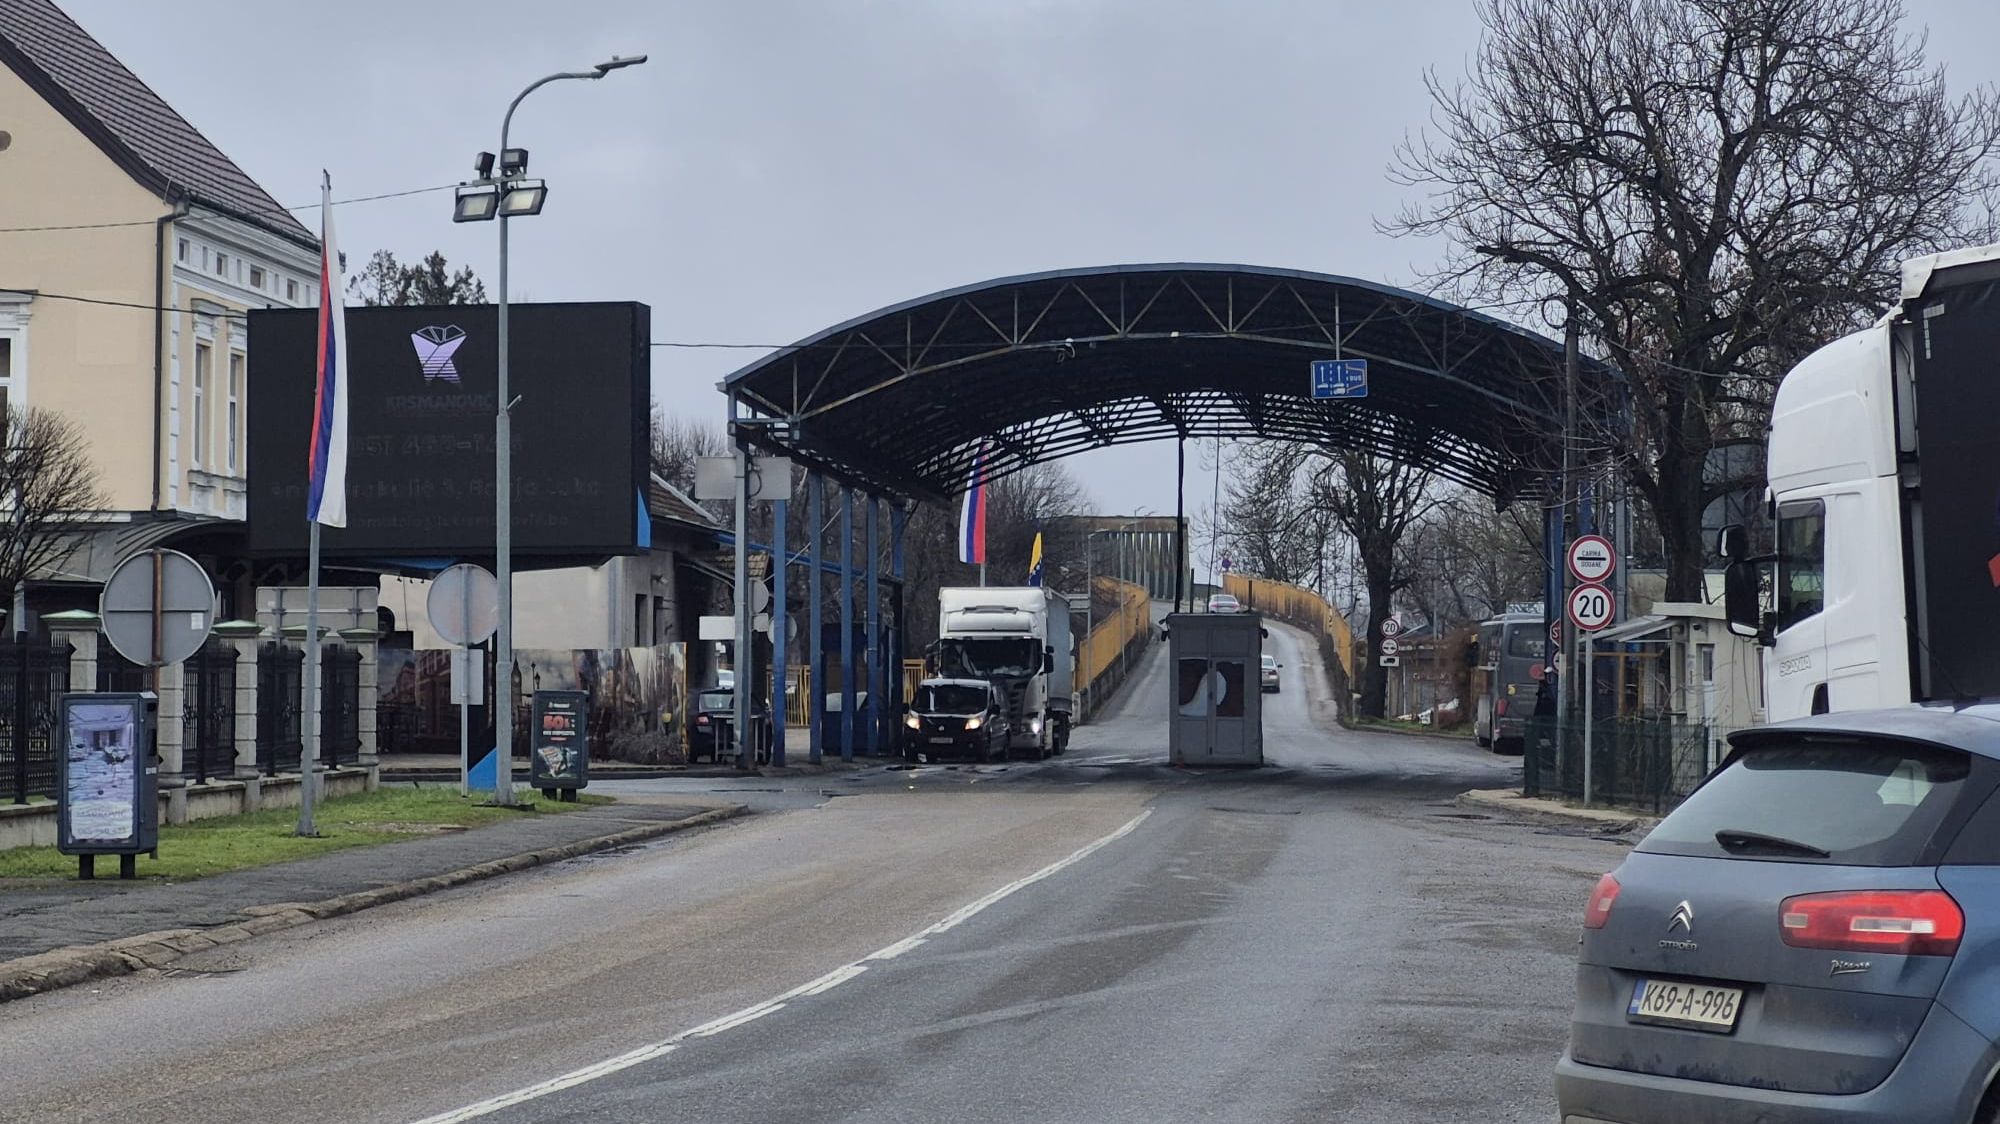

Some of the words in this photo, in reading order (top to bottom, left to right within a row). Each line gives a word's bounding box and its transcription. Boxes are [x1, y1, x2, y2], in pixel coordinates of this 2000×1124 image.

[1579, 595, 1604, 618] 20
[1385, 623, 1395, 632] 20
[1641, 983, 1736, 1020] K69-A-996
